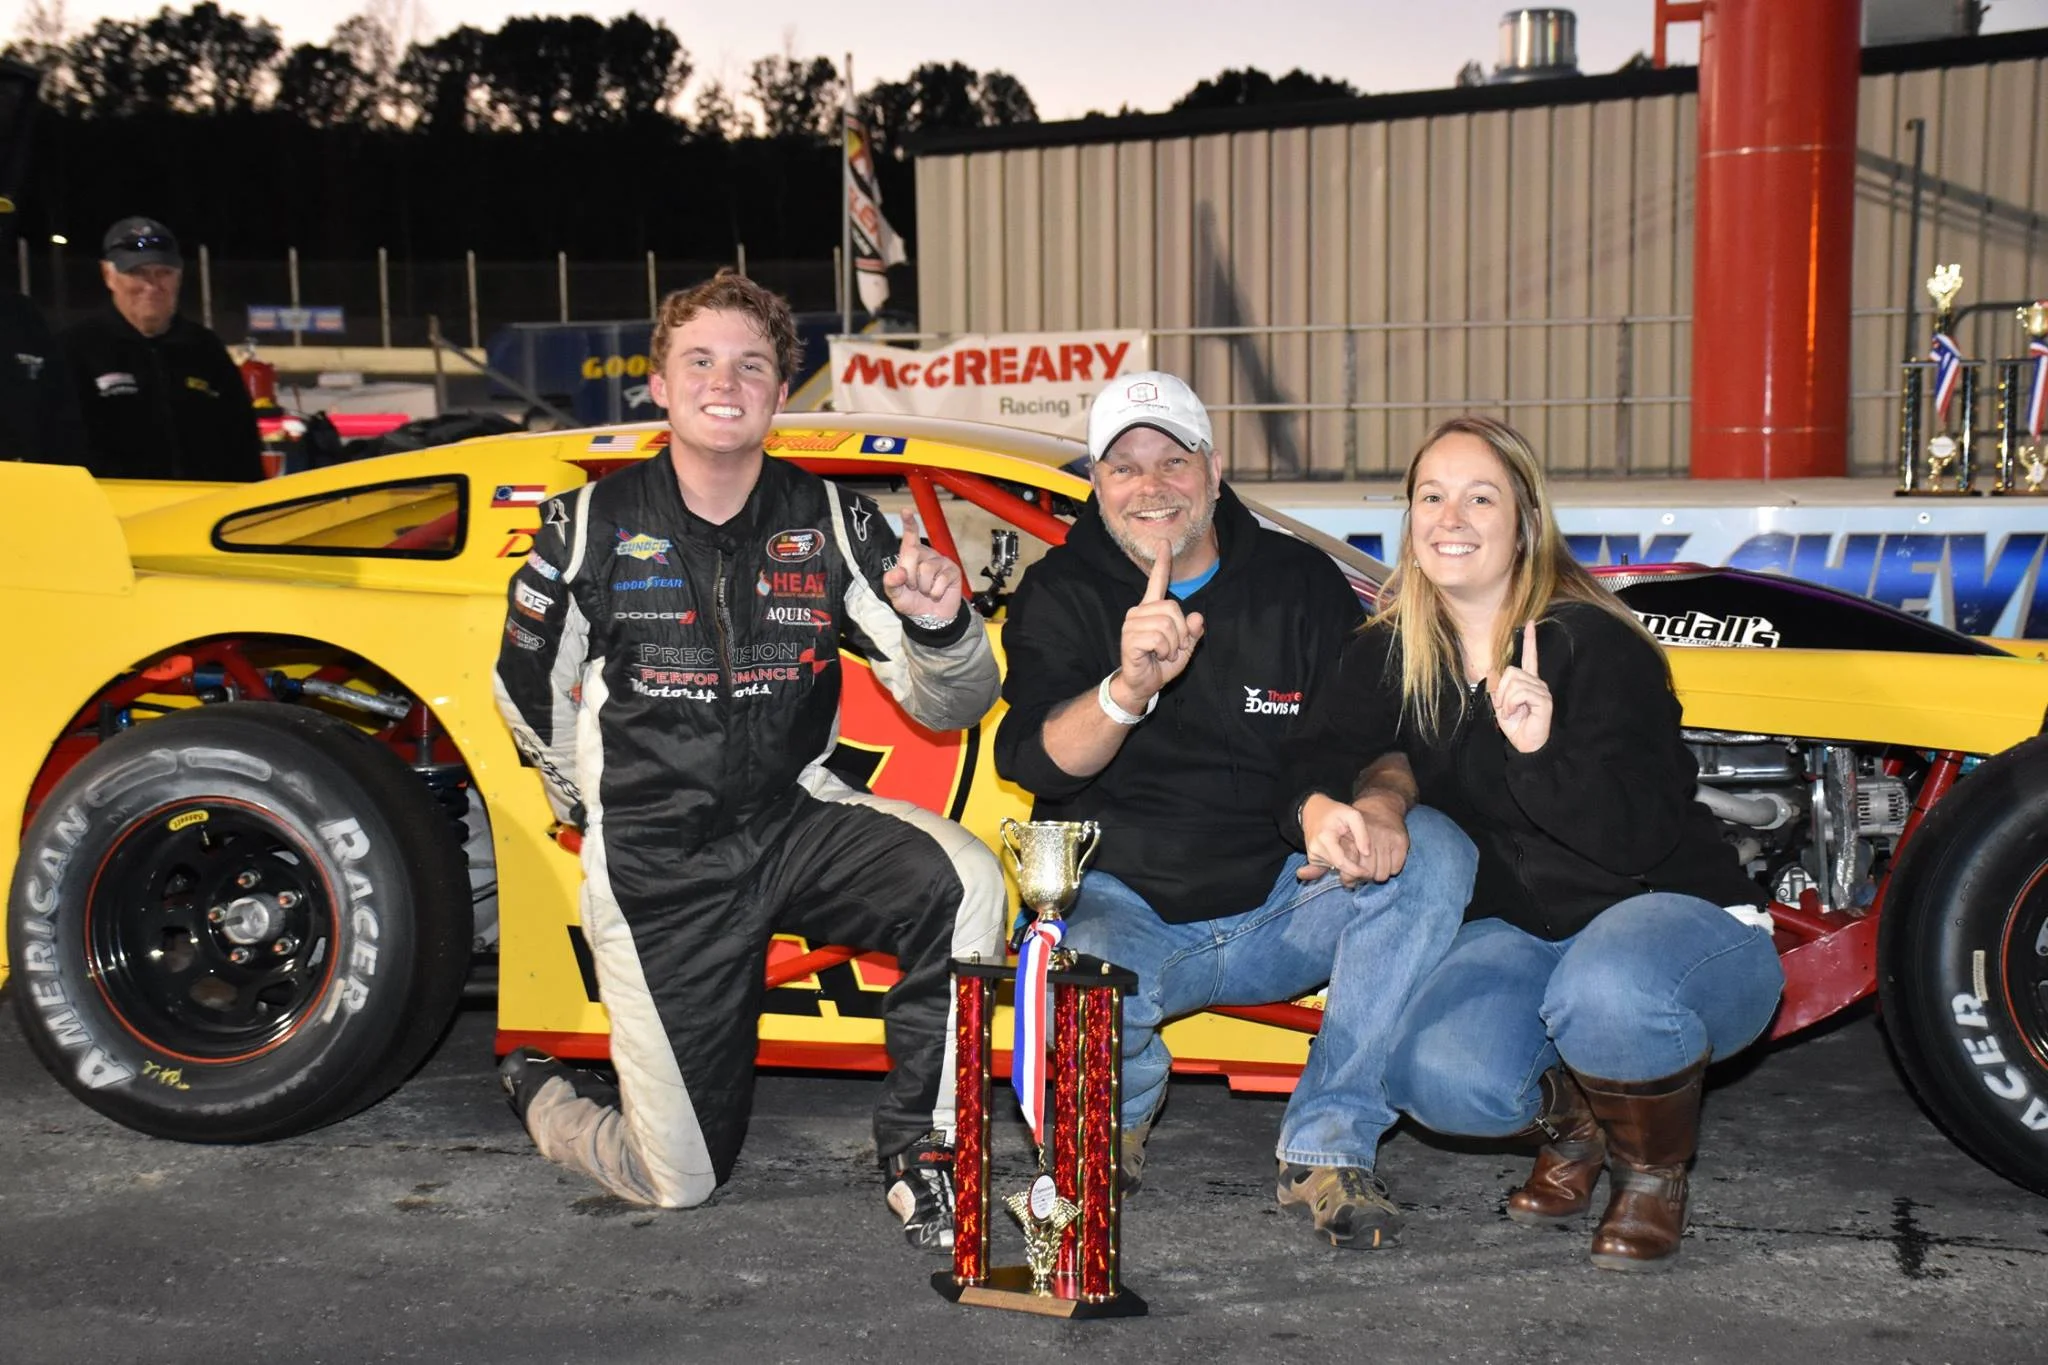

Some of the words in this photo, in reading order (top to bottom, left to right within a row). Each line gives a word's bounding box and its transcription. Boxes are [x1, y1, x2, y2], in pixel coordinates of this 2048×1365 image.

[582, 354, 654, 379] GOO
[1000, 396, 1070, 416] Racing
[619, 541, 668, 553] SUNOCO
[773, 572, 826, 592] HEAT
[1721, 532, 2048, 640] CHEV
[614, 611, 688, 620] DODGE
[766, 607, 811, 623] AQUIS
[320, 817, 379, 1013] RACER
[23, 804, 135, 1090] AMERICAN
